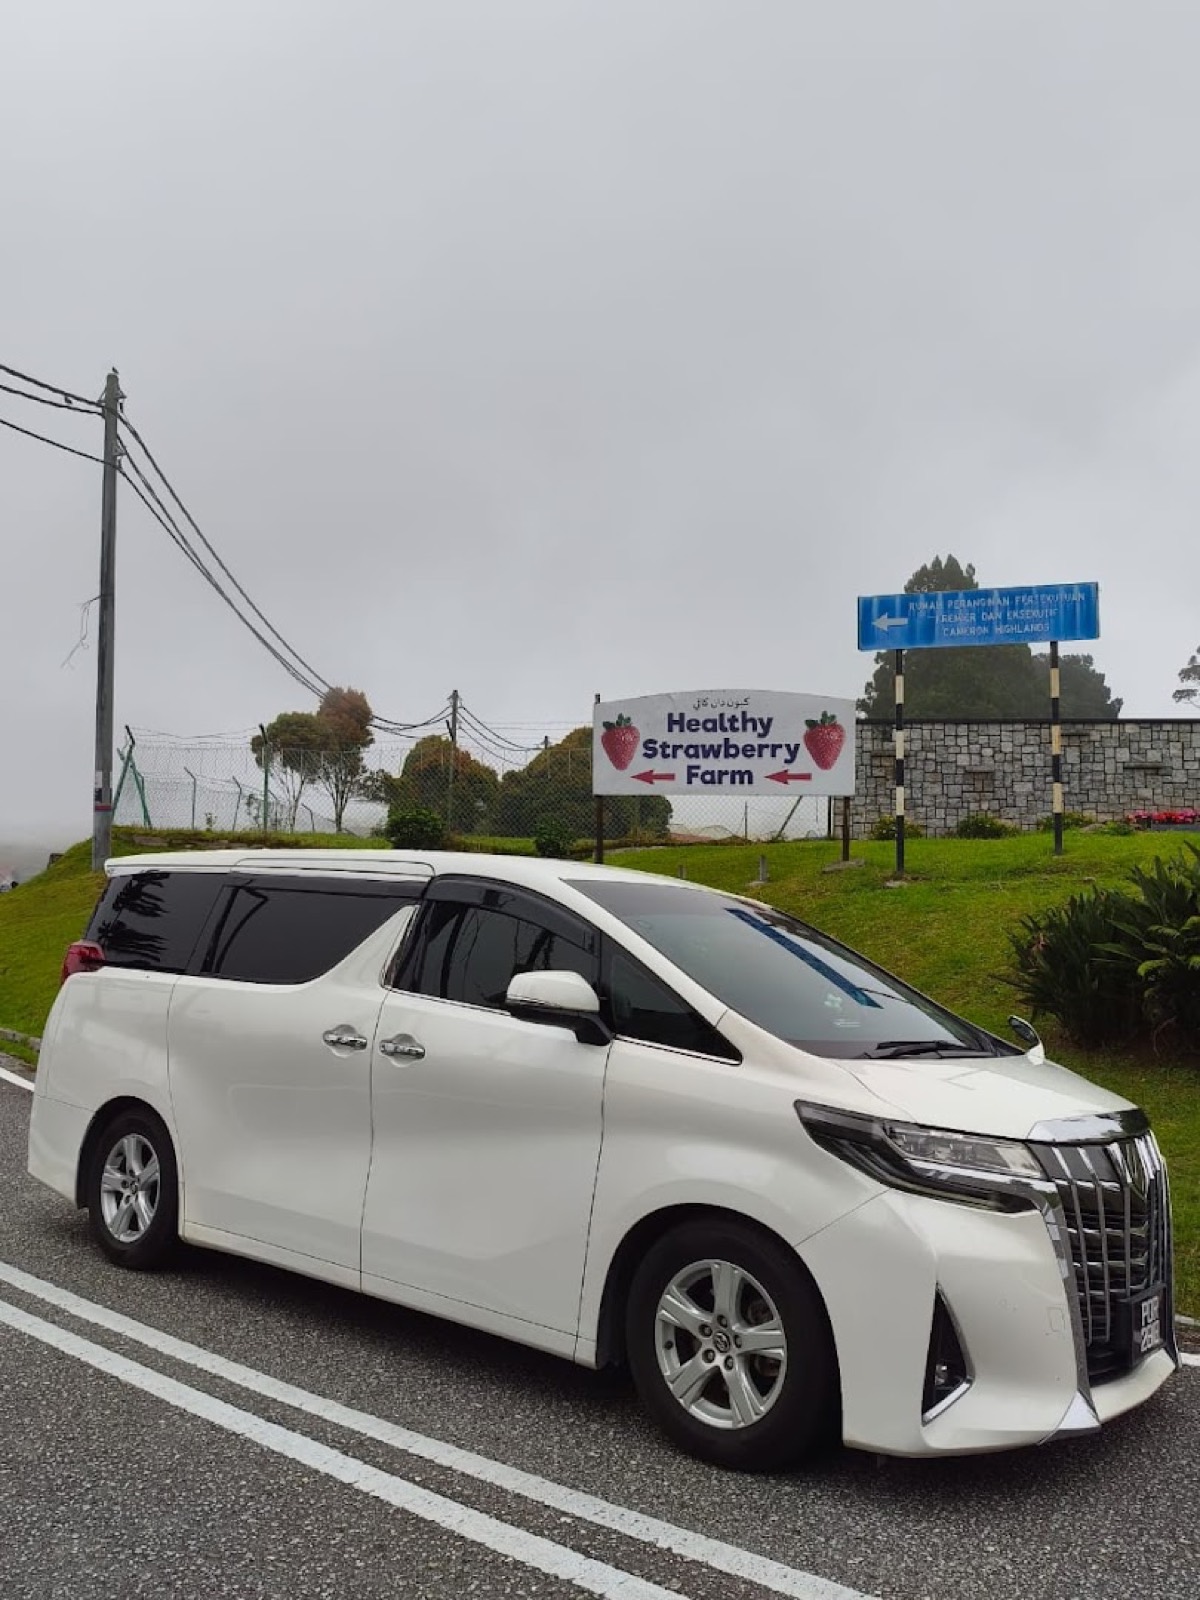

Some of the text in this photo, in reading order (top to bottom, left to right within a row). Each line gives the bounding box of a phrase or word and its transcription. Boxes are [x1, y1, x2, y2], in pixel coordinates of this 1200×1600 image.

[981, 611, 1001, 621] DAN
[943, 623, 1049, 636] CAMERON HIGHLANDS
[667, 710, 773, 738] Healthy
[642, 738, 801, 764] Strawberry
[686, 765, 754, 785] Farm
